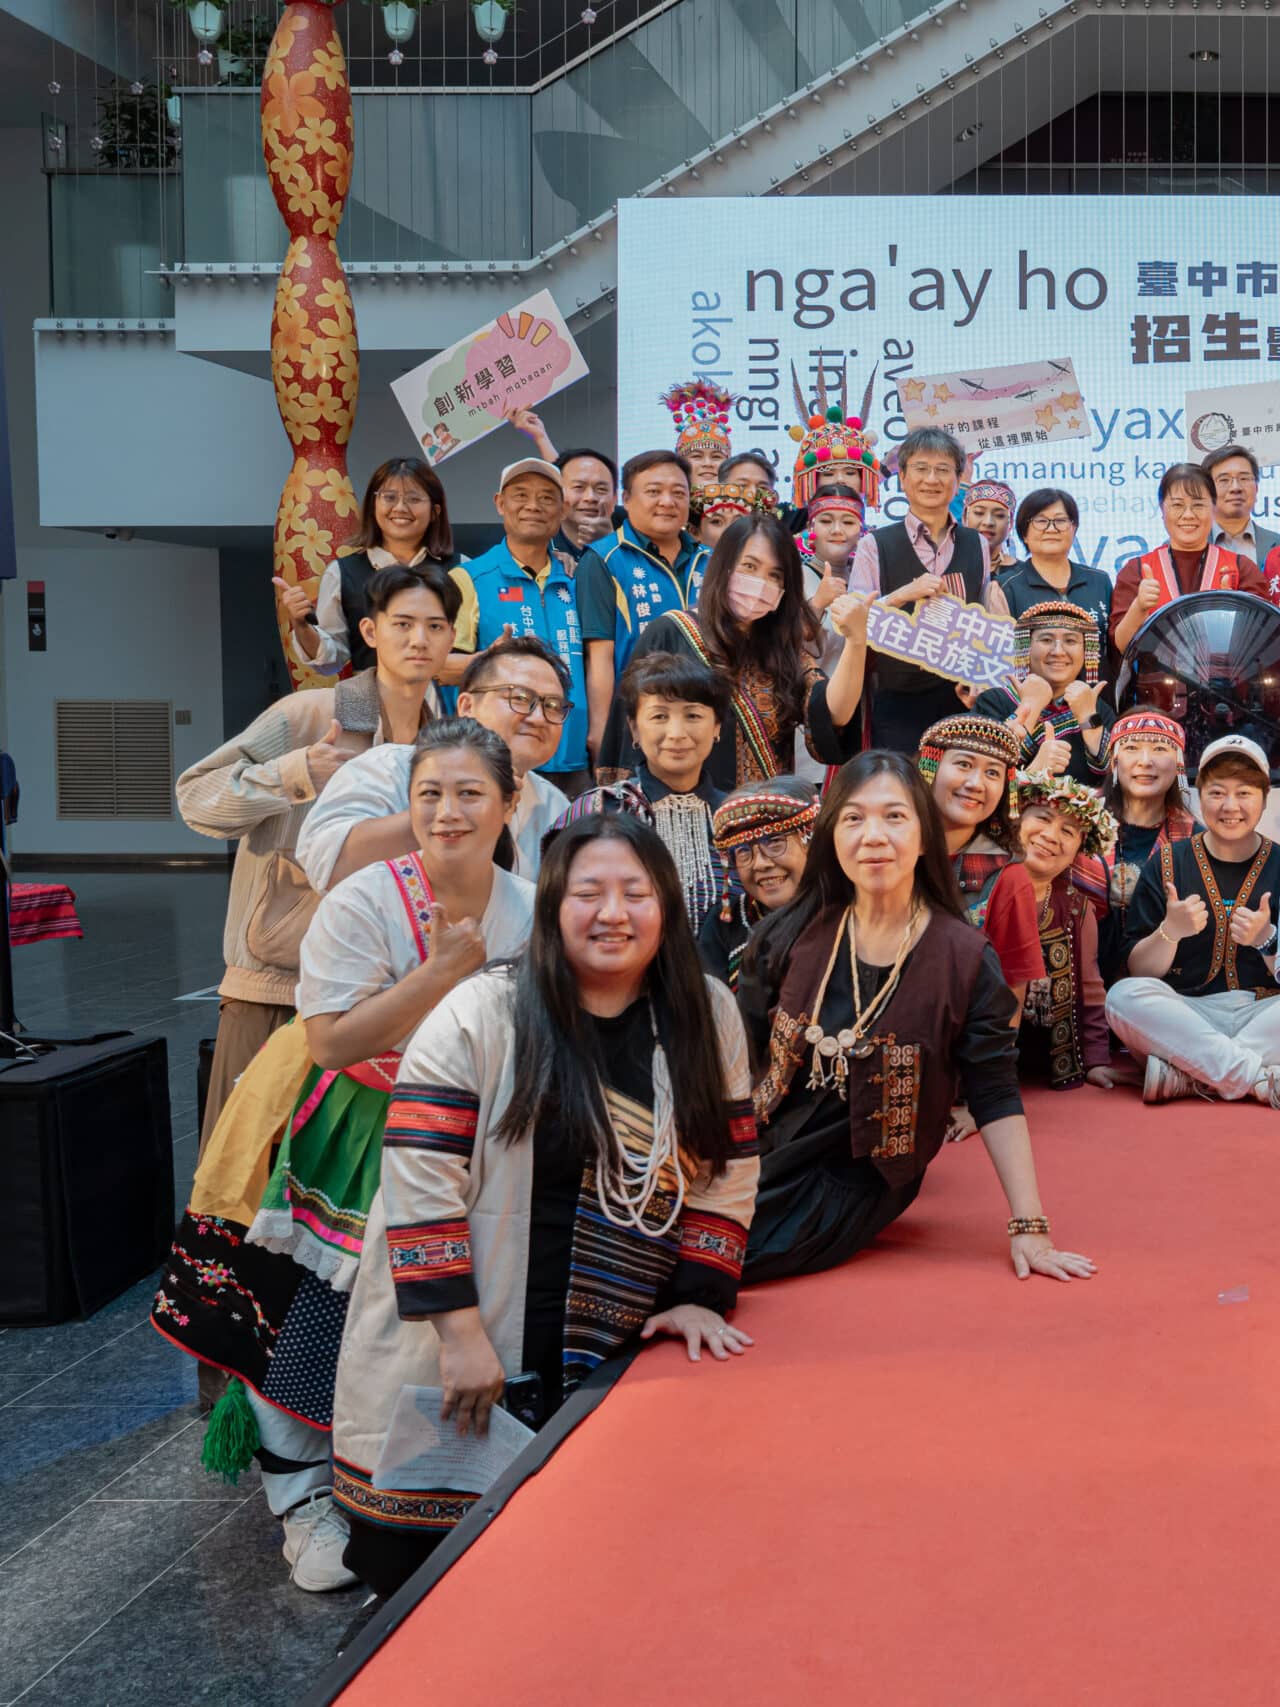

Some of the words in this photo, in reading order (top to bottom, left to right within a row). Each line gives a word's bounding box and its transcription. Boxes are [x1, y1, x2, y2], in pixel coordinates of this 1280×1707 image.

[745, 244, 992, 330] nga'ay
[1017, 249, 1109, 311] ho
[433, 354, 517, 417] 創新學習
[932, 416, 1001, 436] 好的課程
[977, 429, 1049, 450] 從這裡開始
[919, 599, 1016, 655] 臺中市
